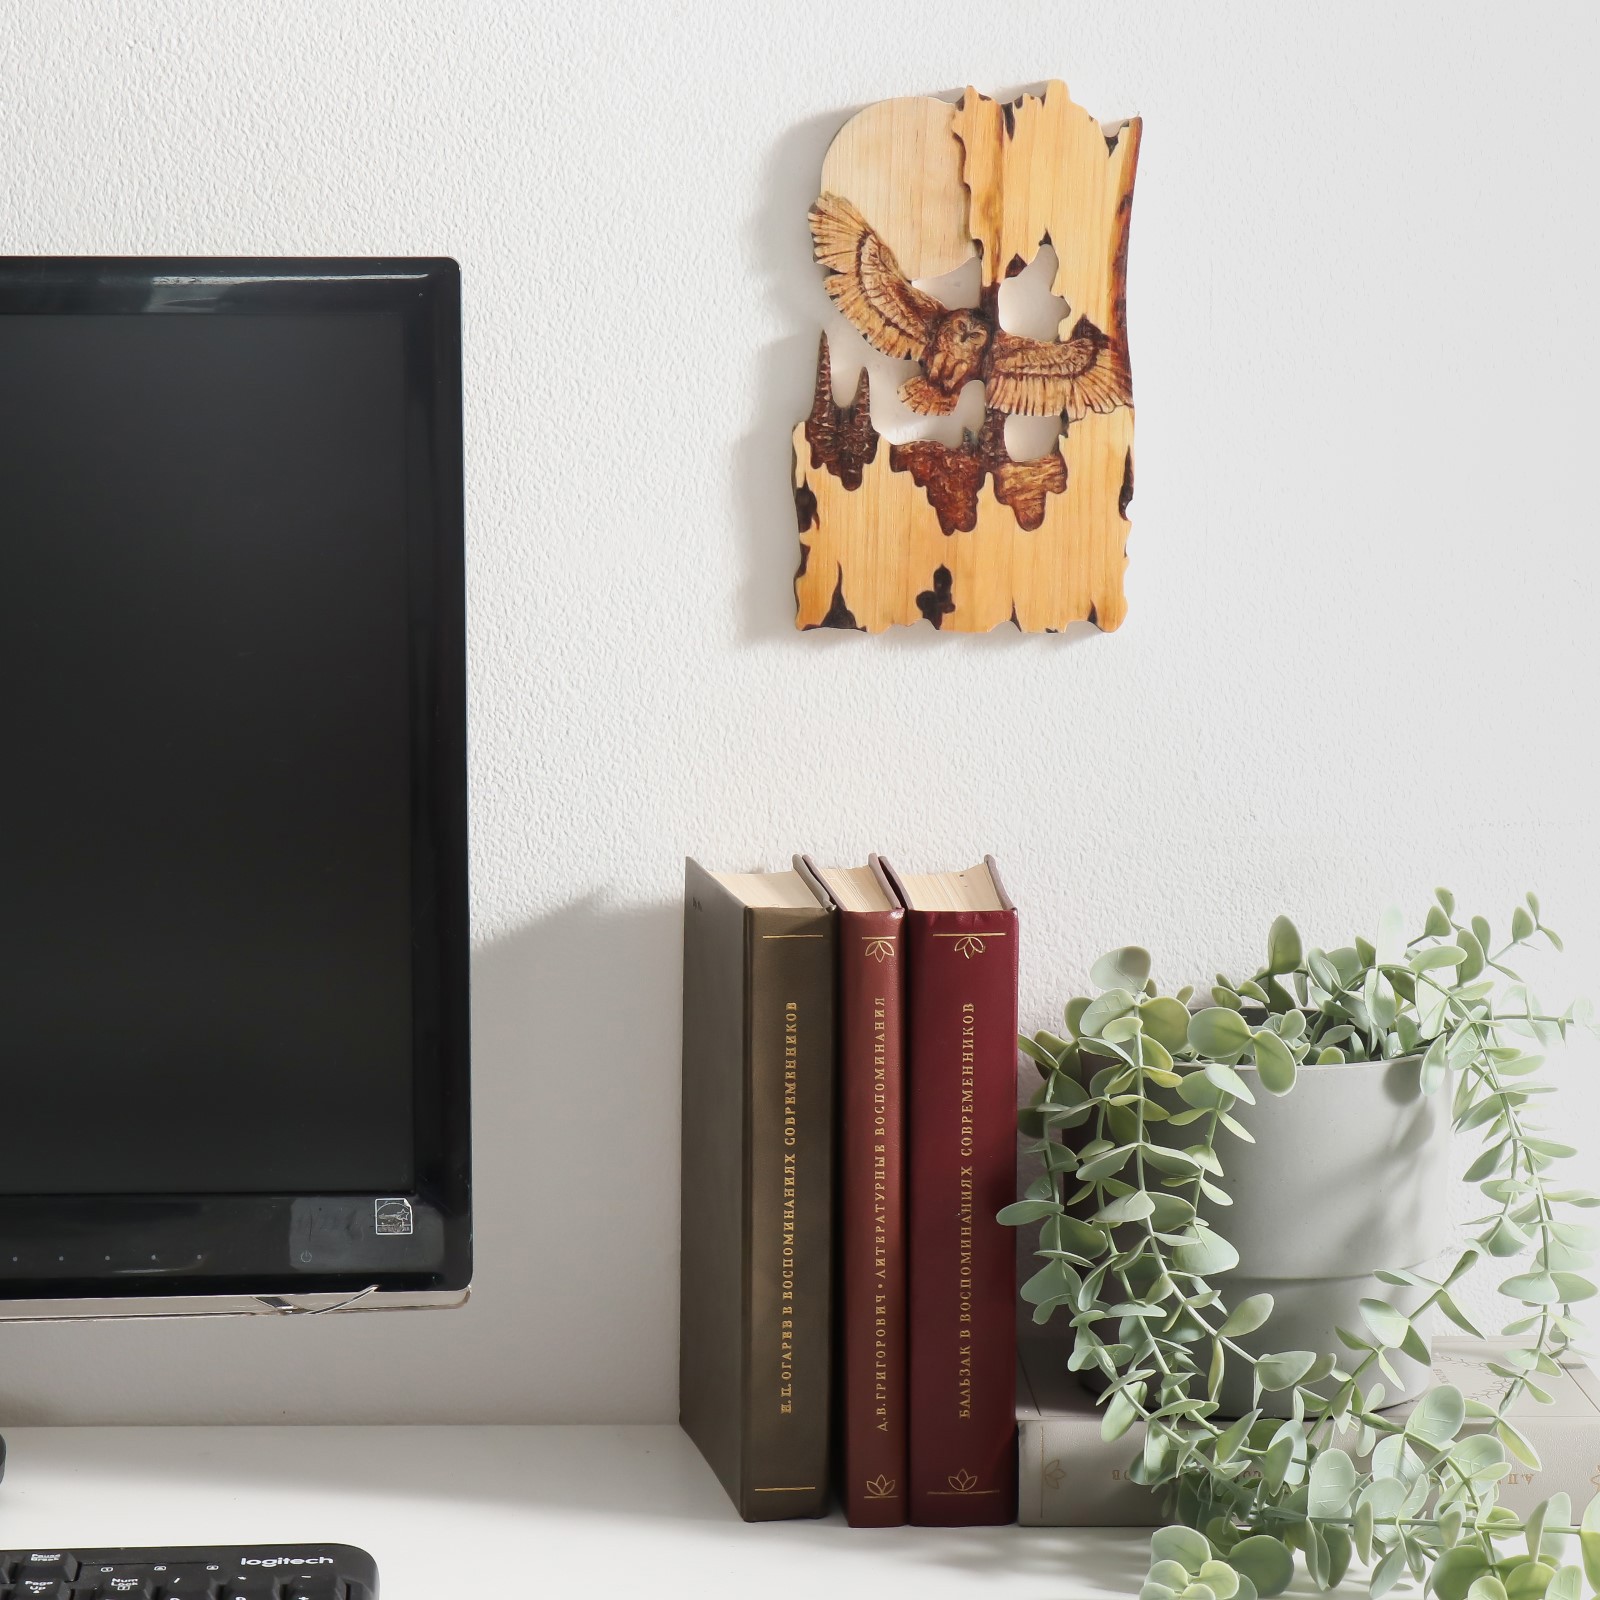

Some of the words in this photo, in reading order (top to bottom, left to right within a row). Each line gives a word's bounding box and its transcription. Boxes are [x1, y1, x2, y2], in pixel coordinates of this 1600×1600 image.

[784, 1002, 798, 1146] СОВРЕМЕННИКОВ
[874, 997, 886, 1137] ВОСПОМИНАНИЯ
[961, 1002, 975, 1157] СОВРЕМЕННИКОВ
[782, 1153, 796, 1301] ВОСПОМИНАНИЯХ
[874, 1144, 887, 1280] ЛИТЕРАТУРНЫЕ
[960, 1165, 973, 1323] ВОСПОМИНАНИЯХ
[782, 1306, 793, 1316] В
[959, 1329, 971, 1339] В
[959, 1345, 971, 1419] БАЛЬЗАК
[241, 1555, 334, 1567] logitech
